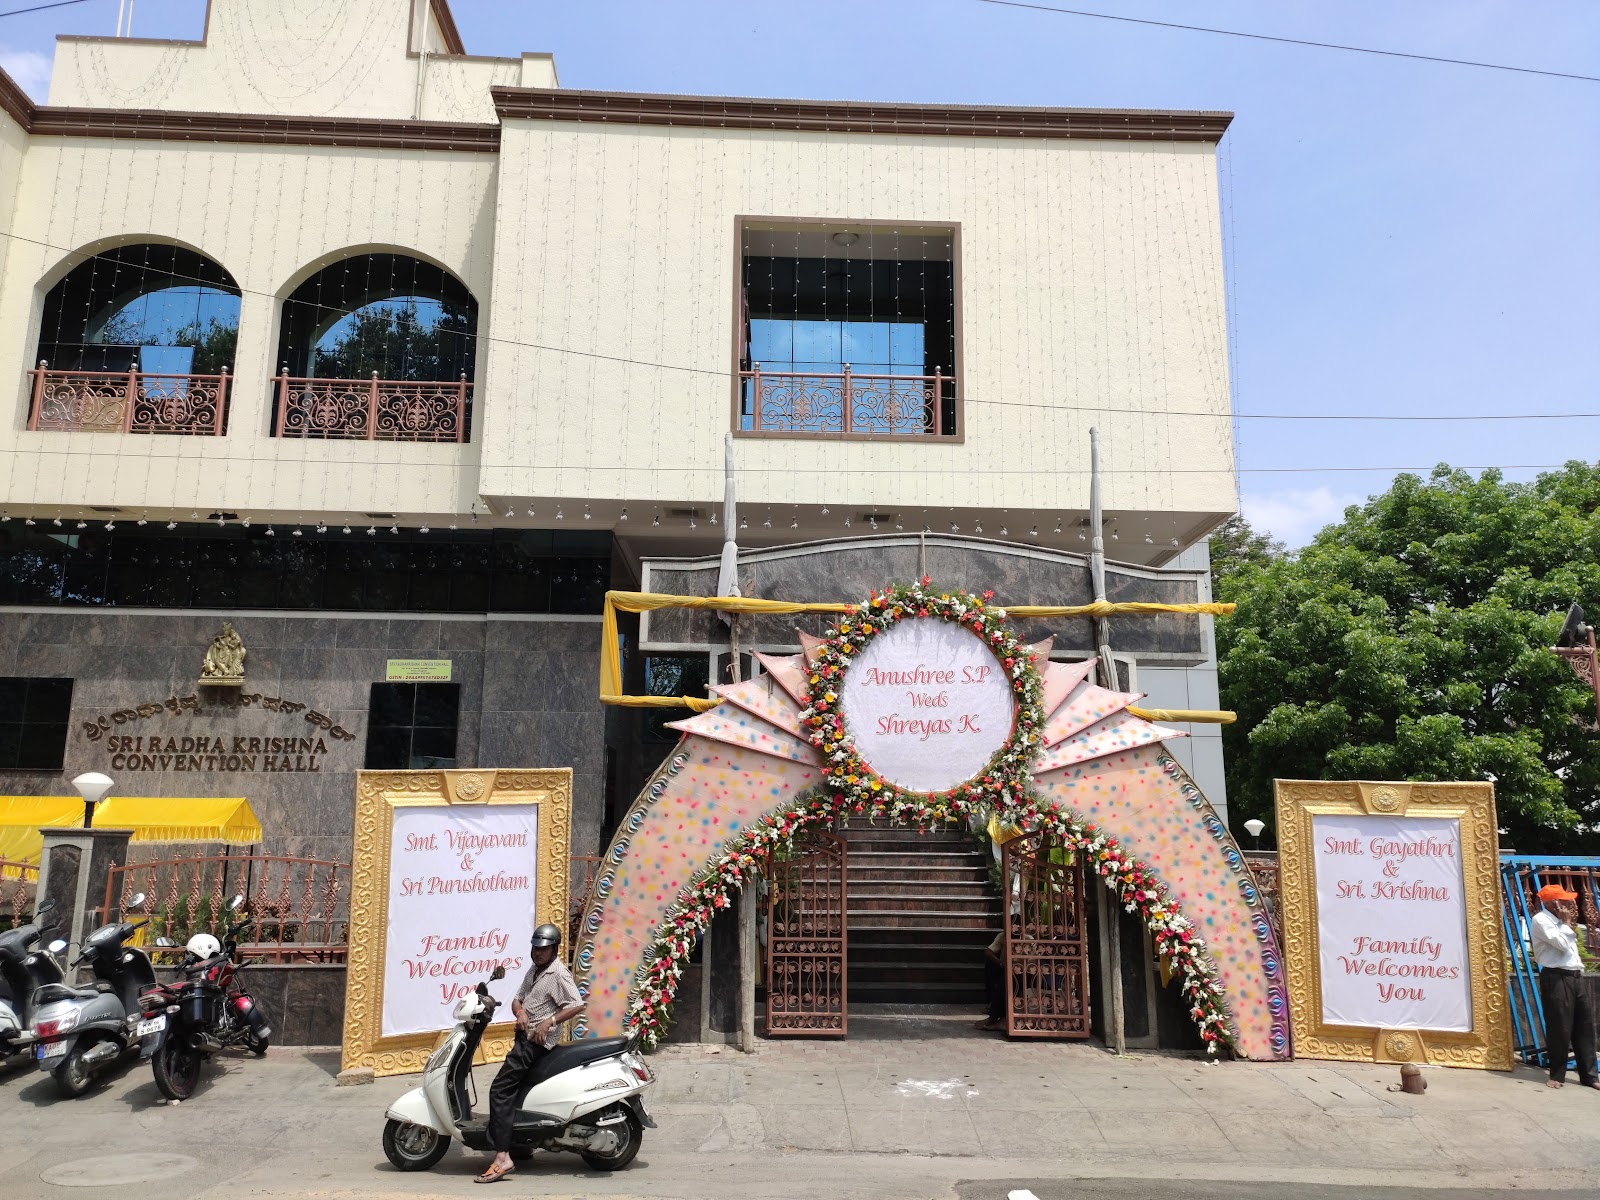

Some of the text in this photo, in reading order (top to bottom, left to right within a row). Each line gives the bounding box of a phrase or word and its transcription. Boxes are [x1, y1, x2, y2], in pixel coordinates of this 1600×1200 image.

[861, 664, 991, 686] Anushree S.P
[906, 691, 949, 708] Weds
[82, 715, 111, 741] ಶ್ರೀ
[876, 713, 952, 741] Shreyas
[107, 735, 328, 754] SRI RADHA KRISHNA
[111, 753, 320, 772] CONVENTION HALL
[404, 829, 530, 856] Smt. Vijayavani
[1323, 836, 1455, 863] Smt. Gayathri
[460, 853, 474, 872] &
[1382, 859, 1399, 878] &
[399, 870, 530, 897] Sri Purushotham
[1335, 879, 1450, 901] Sri. Krishna
[416, 927, 510, 957] Family
[1350, 936, 1442, 961] Family
[401, 955, 523, 979] Welcomes
[1337, 955, 1460, 979] Welcomes
[440, 983, 479, 1005] Yo
[1376, 981, 1426, 1003] You
